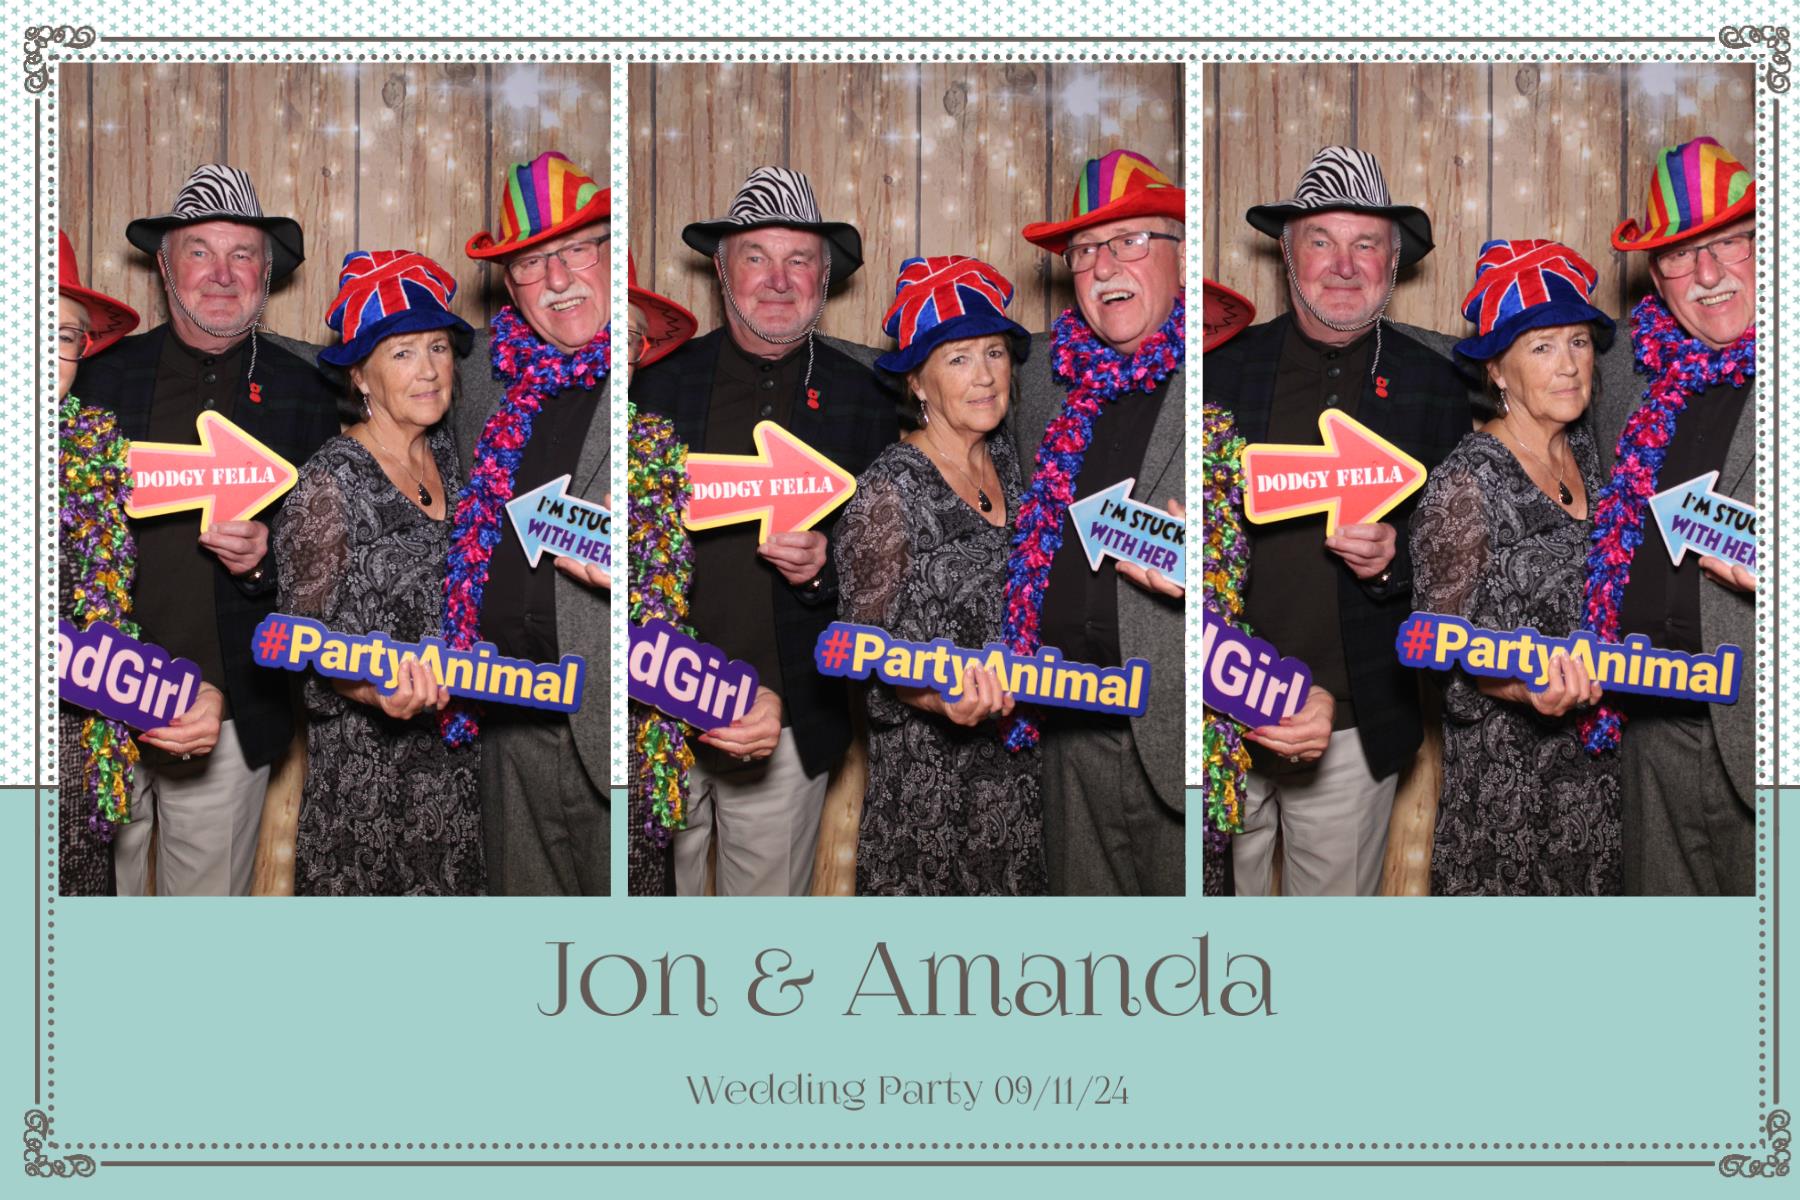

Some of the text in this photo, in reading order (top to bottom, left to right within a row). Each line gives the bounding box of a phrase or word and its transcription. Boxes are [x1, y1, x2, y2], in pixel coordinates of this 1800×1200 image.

[136, 465, 277, 489] DODGY FELLA
[693, 475, 835, 501] DODGY FELLA
[1256, 465, 1404, 494] DODGY FELLA
[537, 495, 565, 518] I'M
[1682, 491, 1711, 516] I'M
[527, 518, 577, 552] WITH
[1100, 499, 1185, 546] I'M STUCK
[1671, 514, 1724, 552] WITH
[1090, 521, 1178, 573] WITH HER
[259, 622, 577, 705] #PartyAnimal
[821, 630, 1144, 708] #PartyAnimal
[1402, 622, 1735, 696] #PartyAnimal
